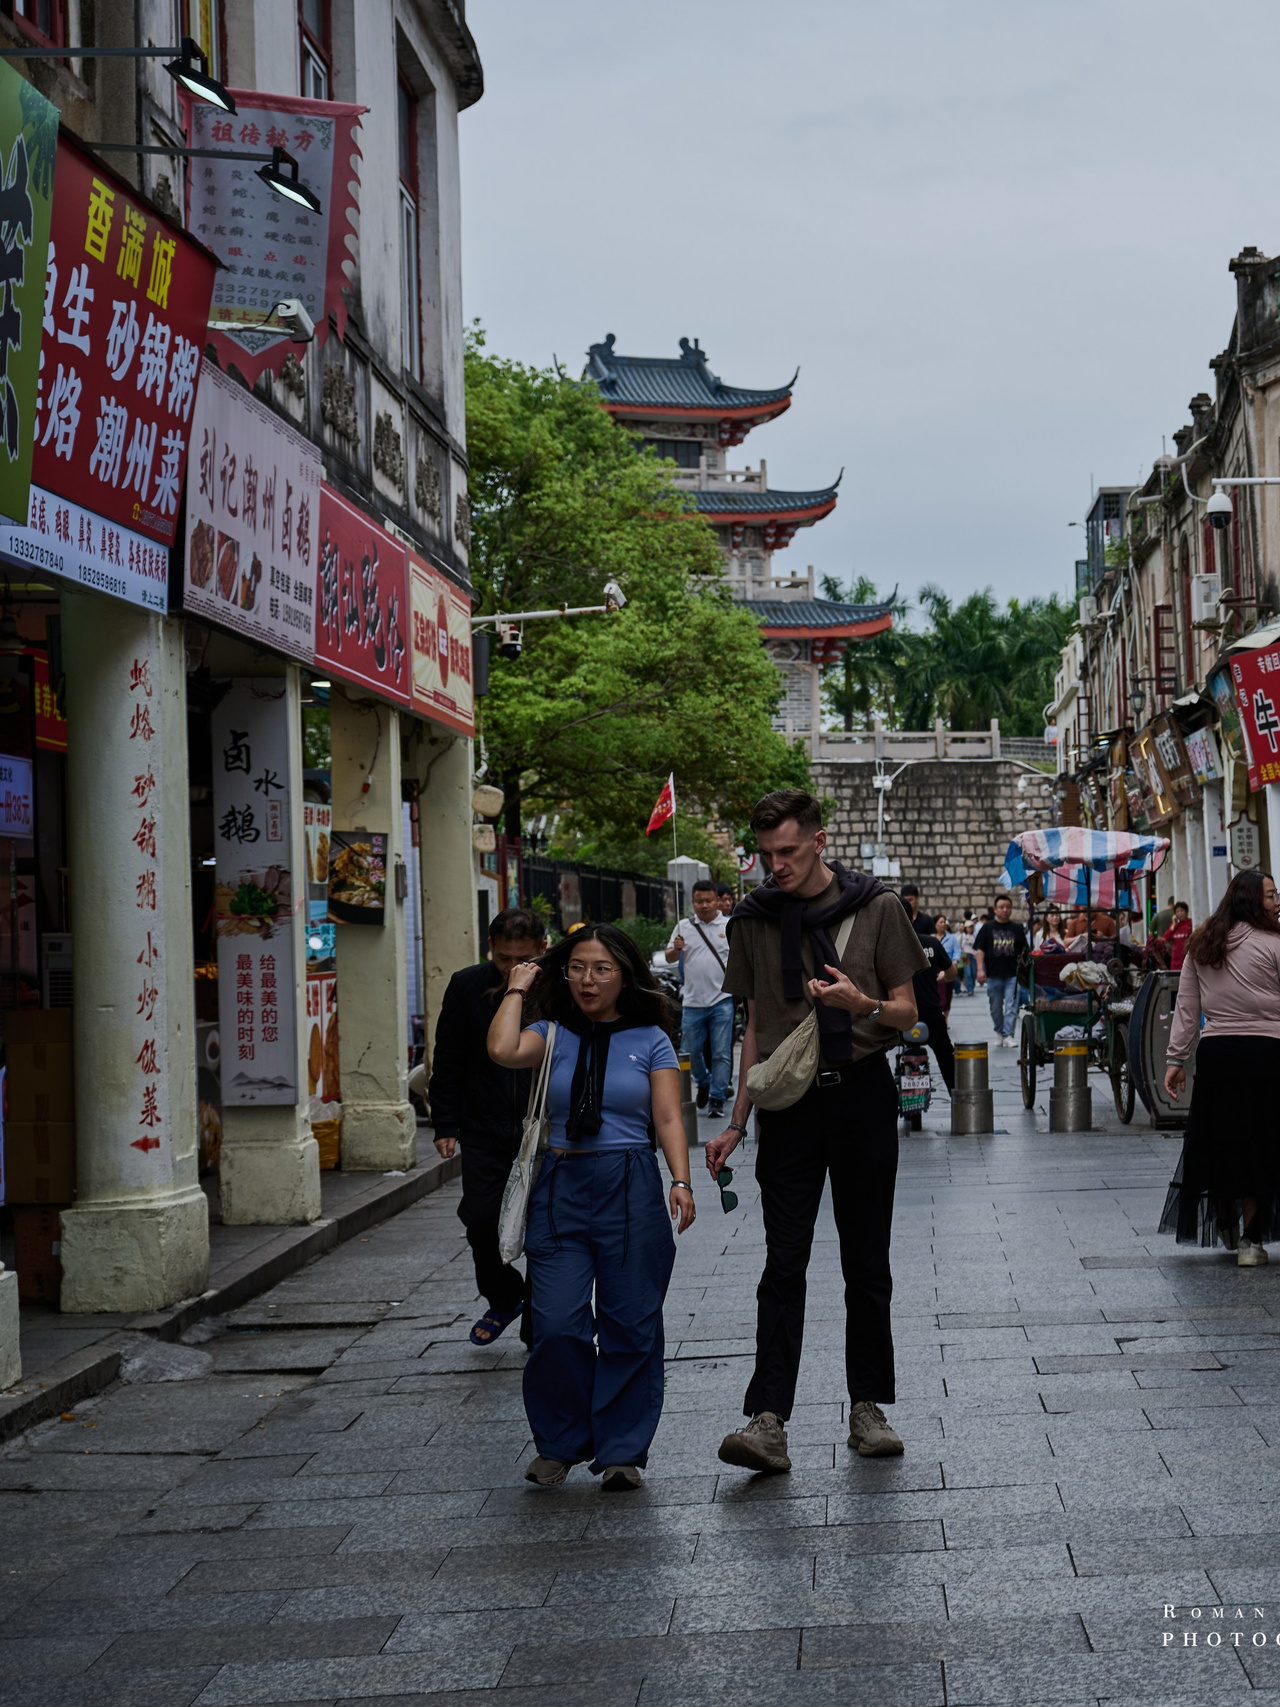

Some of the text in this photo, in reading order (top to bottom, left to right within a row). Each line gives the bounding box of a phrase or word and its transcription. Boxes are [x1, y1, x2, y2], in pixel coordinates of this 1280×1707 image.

[211, 120, 315, 151] 祖传秘方
[84, 177, 177, 310] 香满城
[219, 263, 306, 284] 类皮肤疾病
[106, 300, 200, 422] 砂锅粥
[33, 350, 185, 516] 烙 潮州菜
[9, 535, 126, 595] 13332787840 18529596816
[236, 953, 255, 1061] 最美味的时刻
[259, 953, 279, 1043] 给最美的您
